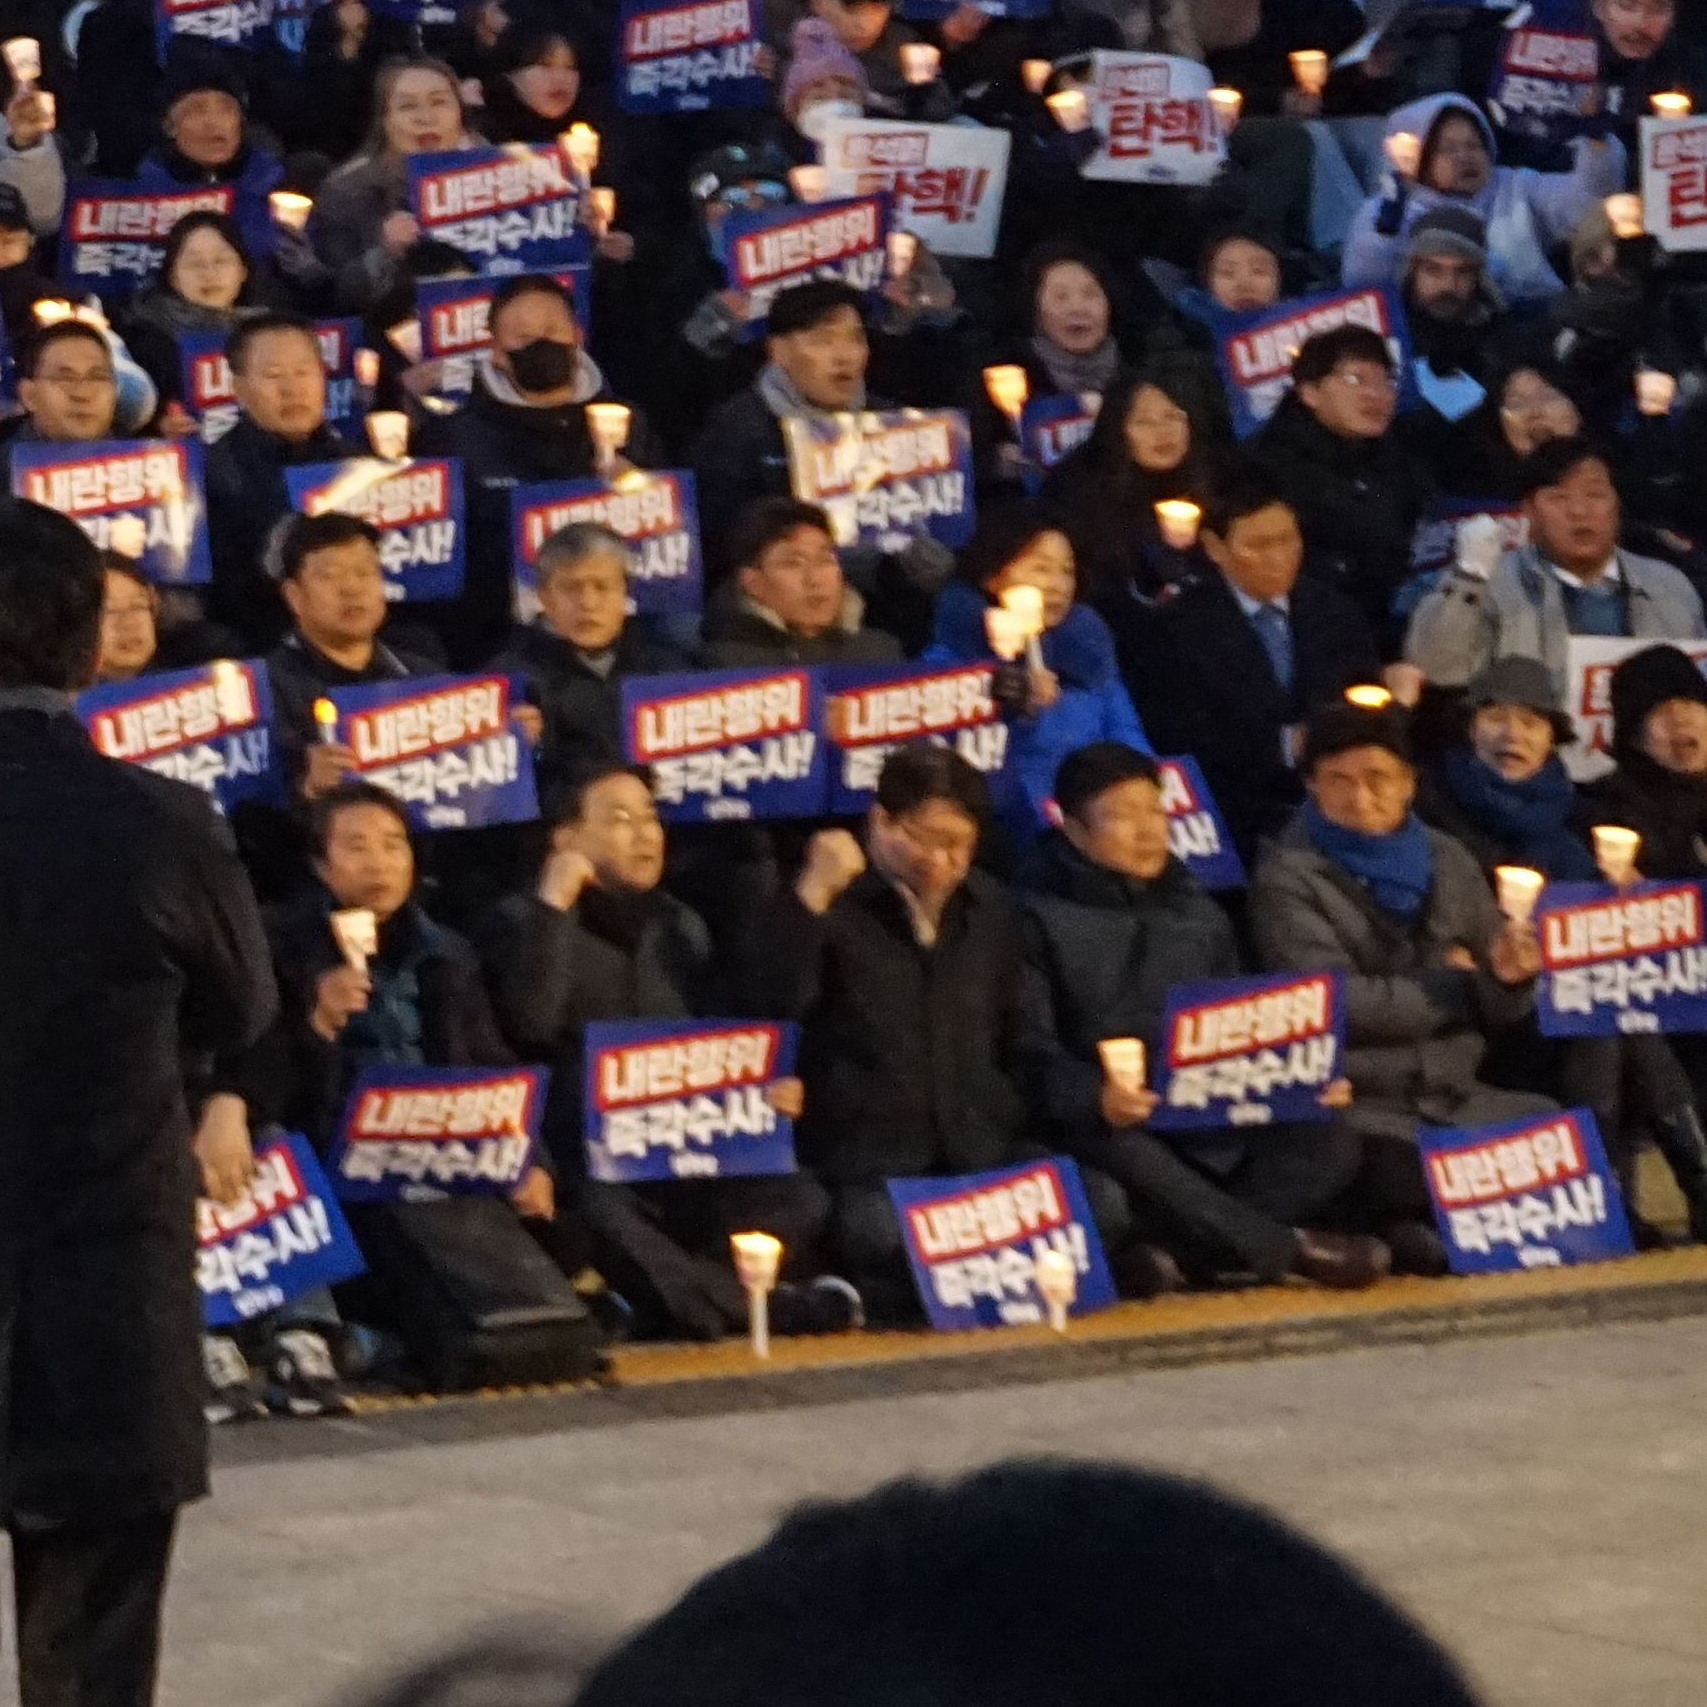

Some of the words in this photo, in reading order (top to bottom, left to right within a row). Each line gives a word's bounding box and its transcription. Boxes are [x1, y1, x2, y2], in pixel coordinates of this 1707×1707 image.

[632, 0, 749, 55] 내란행위
[1109, 100, 1222, 155] 탄핵!
[741, 204, 874, 276] 내란행위
[353, 680, 495, 754] 내란행위
[639, 680, 804, 752] 내란행위
[655, 735, 815, 802] 즉각수사!
[1545, 893, 1701, 966] 내란행위
[1176, 987, 1326, 1053] 내란행위
[602, 1032, 771, 1100] 내란행위
[1167, 1038, 1336, 1108] 즉각수사!
[359, 1081, 529, 1136] 내란행위
[607, 1087, 775, 1157] 즉각수사!
[1427, 1125, 1577, 1201] 내란행위
[911, 1175, 1060, 1256] 내란행위
[1447, 1178, 1607, 1252] 즉각수사!
